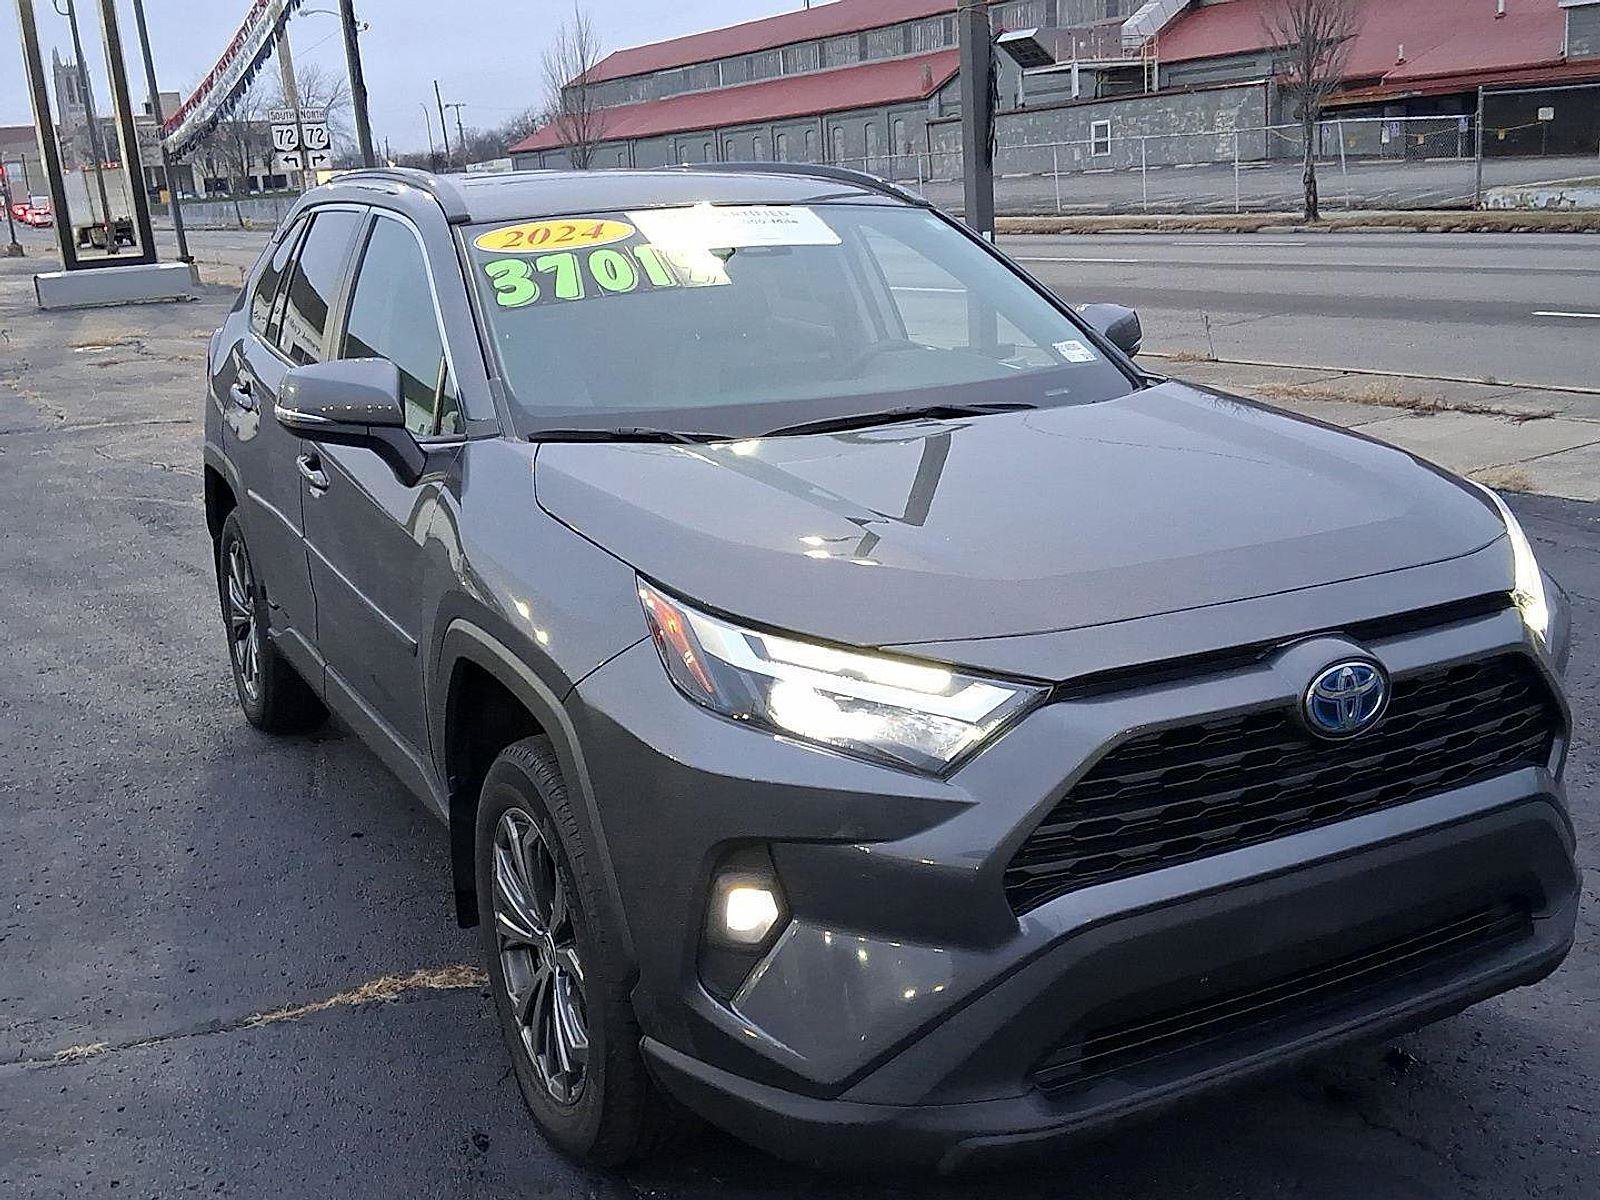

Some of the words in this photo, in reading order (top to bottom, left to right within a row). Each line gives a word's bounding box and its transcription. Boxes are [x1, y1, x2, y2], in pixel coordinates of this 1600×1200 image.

[270, 110, 295, 120] SOUTH
[301, 109, 325, 119] NORTH
[276, 129, 296, 145] 72
[306, 128, 326, 144] 72
[500, 223, 606, 249] 2024
